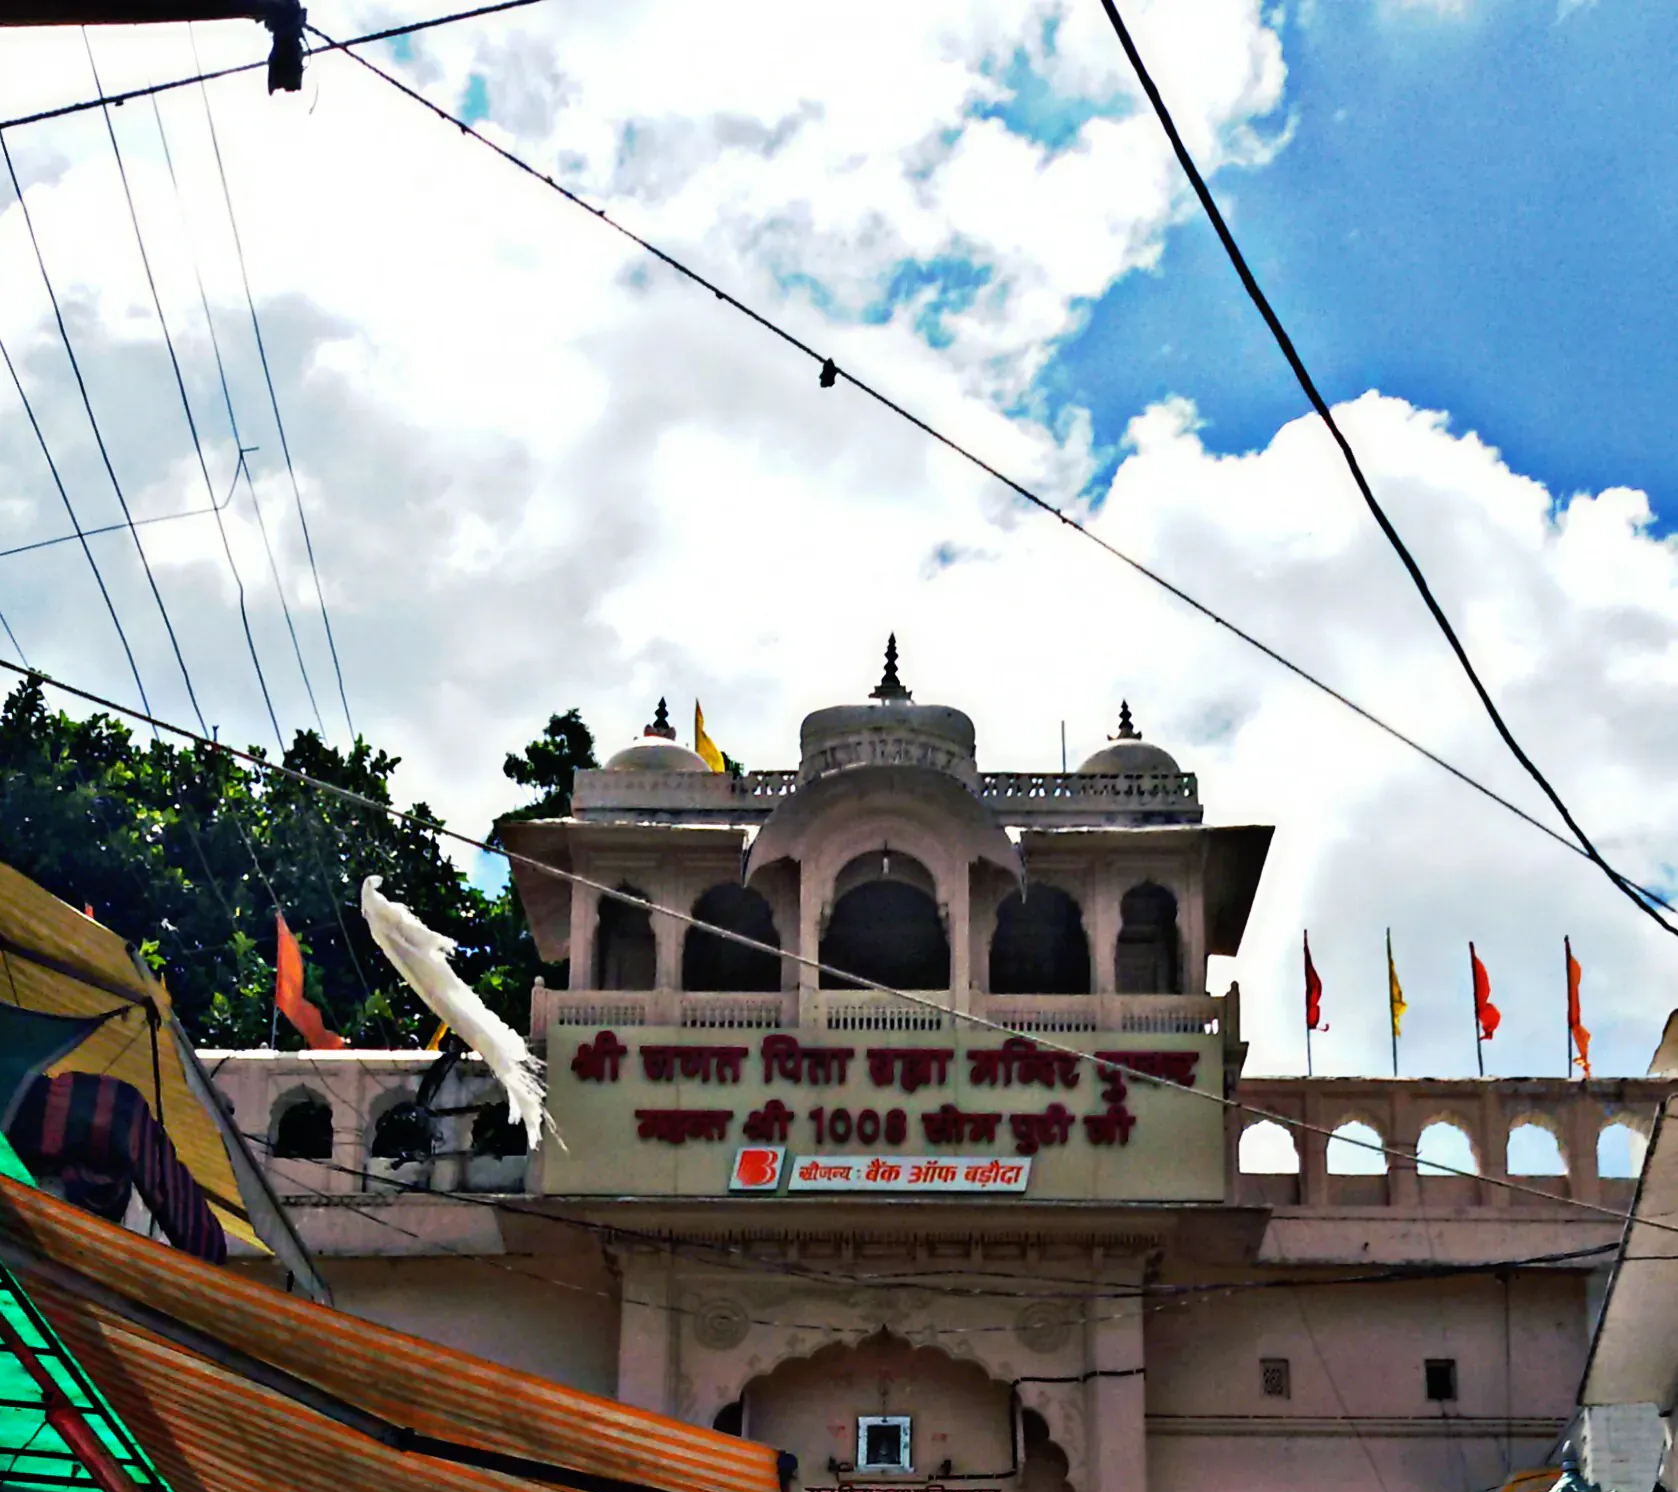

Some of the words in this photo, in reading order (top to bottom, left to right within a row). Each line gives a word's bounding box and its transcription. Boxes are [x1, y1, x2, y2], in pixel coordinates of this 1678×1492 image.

[571, 1030, 627, 1083] श्री
[761, 1034, 855, 1085] पिता
[743, 1099, 795, 1143] श्री
[809, 1105, 908, 1146] 1008
[1009, 1103, 1076, 1156] पुरी
[865, 1158, 902, 1183] बैंक
[908, 1159, 958, 1184] ऑफ
